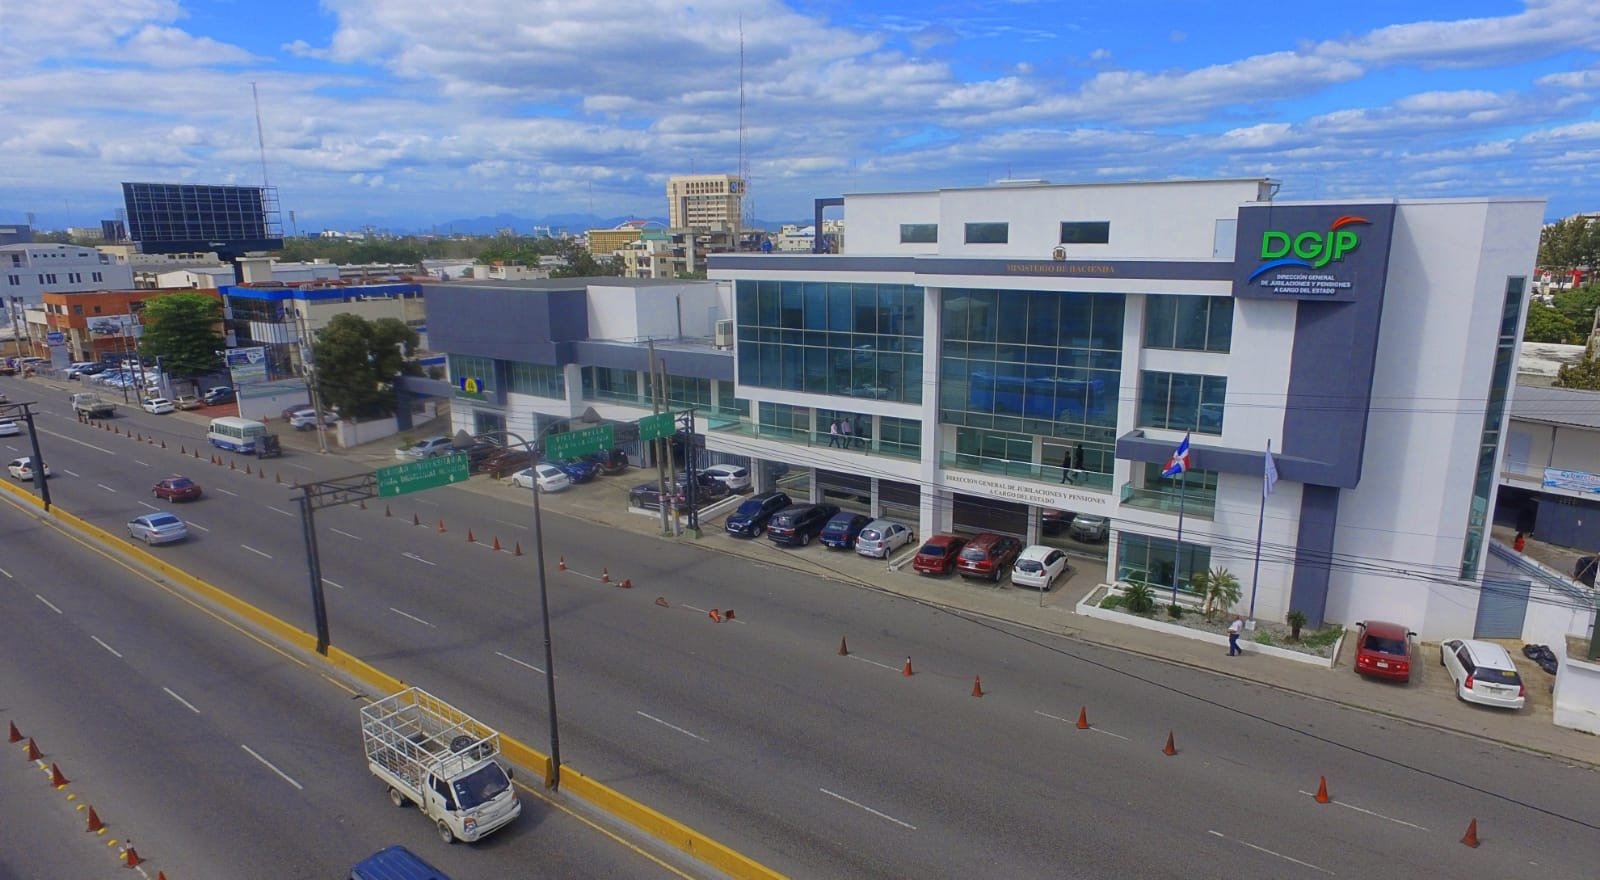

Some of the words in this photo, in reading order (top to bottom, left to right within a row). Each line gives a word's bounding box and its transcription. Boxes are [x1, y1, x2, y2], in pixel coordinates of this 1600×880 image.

[1261, 231, 1357, 268] DGJP
[1007, 264, 1054, 273] MINISTERIO
[1056, 265, 1066, 273] DE
[1069, 265, 1115, 273] HACIENDA
[979, 480, 1006, 489] GENERAL
[1017, 485, 1062, 497] JUBILACIONES
[1068, 493, 1106, 505] PENSIONES
[994, 489, 1016, 498] CARGO
[1029, 495, 1055, 504] ESTADO
